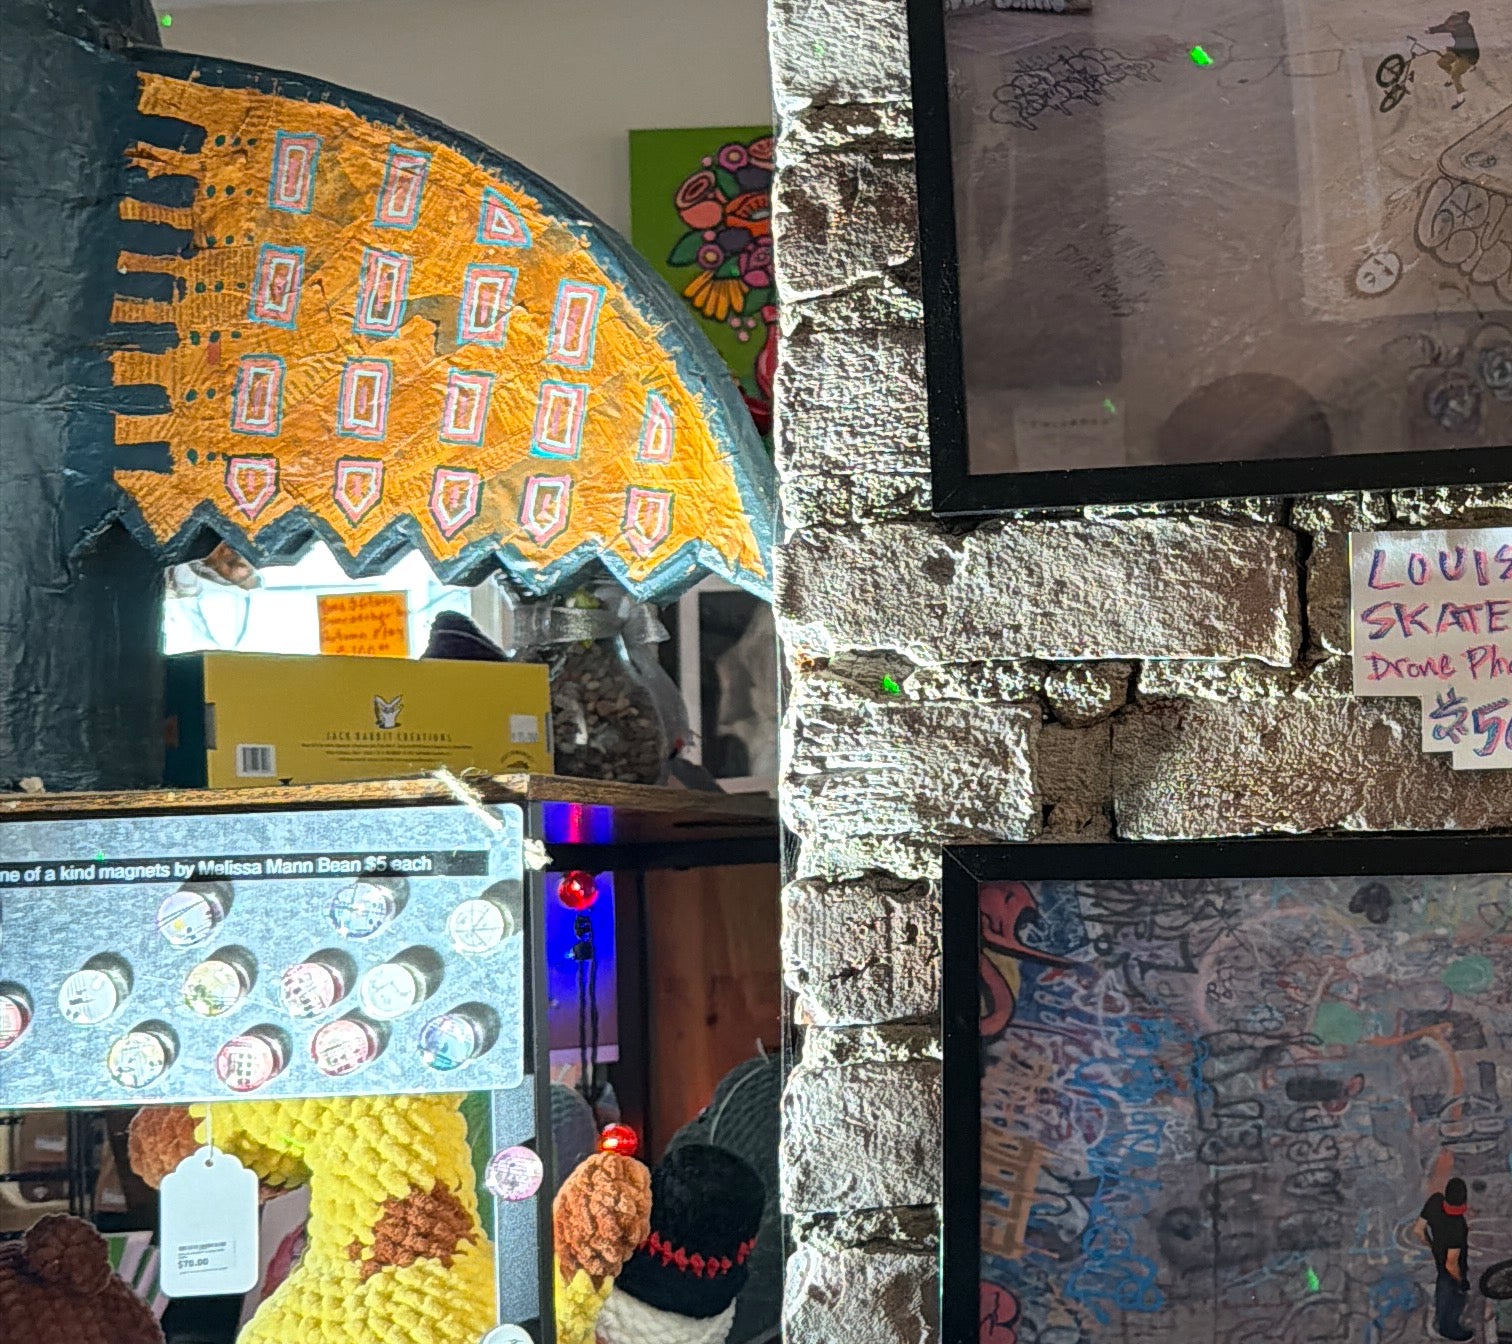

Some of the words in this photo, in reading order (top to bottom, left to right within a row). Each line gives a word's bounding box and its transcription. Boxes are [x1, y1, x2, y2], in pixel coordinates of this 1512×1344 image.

[1360, 598, 1510, 641] SKATE
[0, 868, 20, 883] ne
[24, 865, 42, 882] of
[45, 869, 56, 881] a
[60, 864, 96, 881] kind
[99, 862, 170, 885] magnets
[173, 861, 195, 882] by
[199, 858, 262, 876] Melissa
[266, 857, 313, 875] Mann
[318, 856, 361, 873] Bean
[364, 855, 387, 873] $5
[391, 855, 432, 872] each
